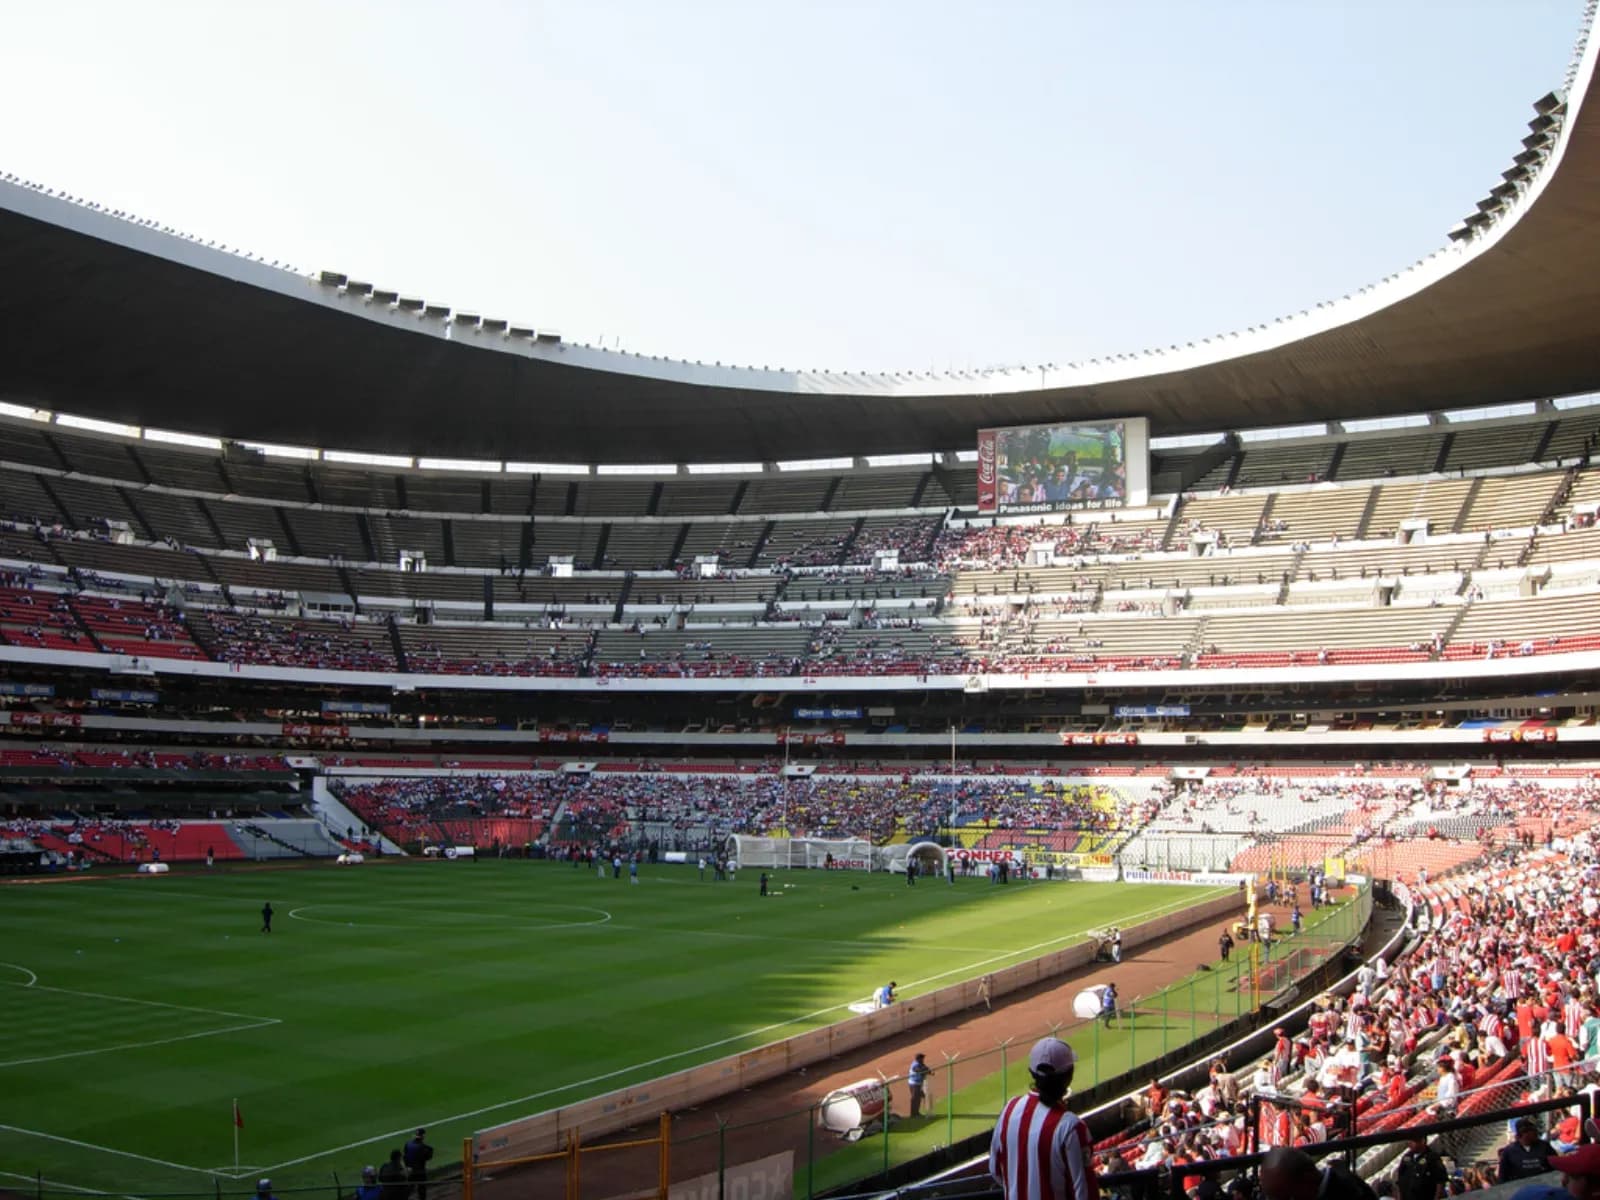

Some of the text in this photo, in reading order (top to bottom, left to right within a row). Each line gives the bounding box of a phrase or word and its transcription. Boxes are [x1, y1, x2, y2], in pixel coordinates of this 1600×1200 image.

[979, 440, 995, 484] Coca-Cola
[1000, 503, 1053, 514] Panasonic
[1087, 499, 1102, 509] for
[1105, 497, 1122, 508] life
